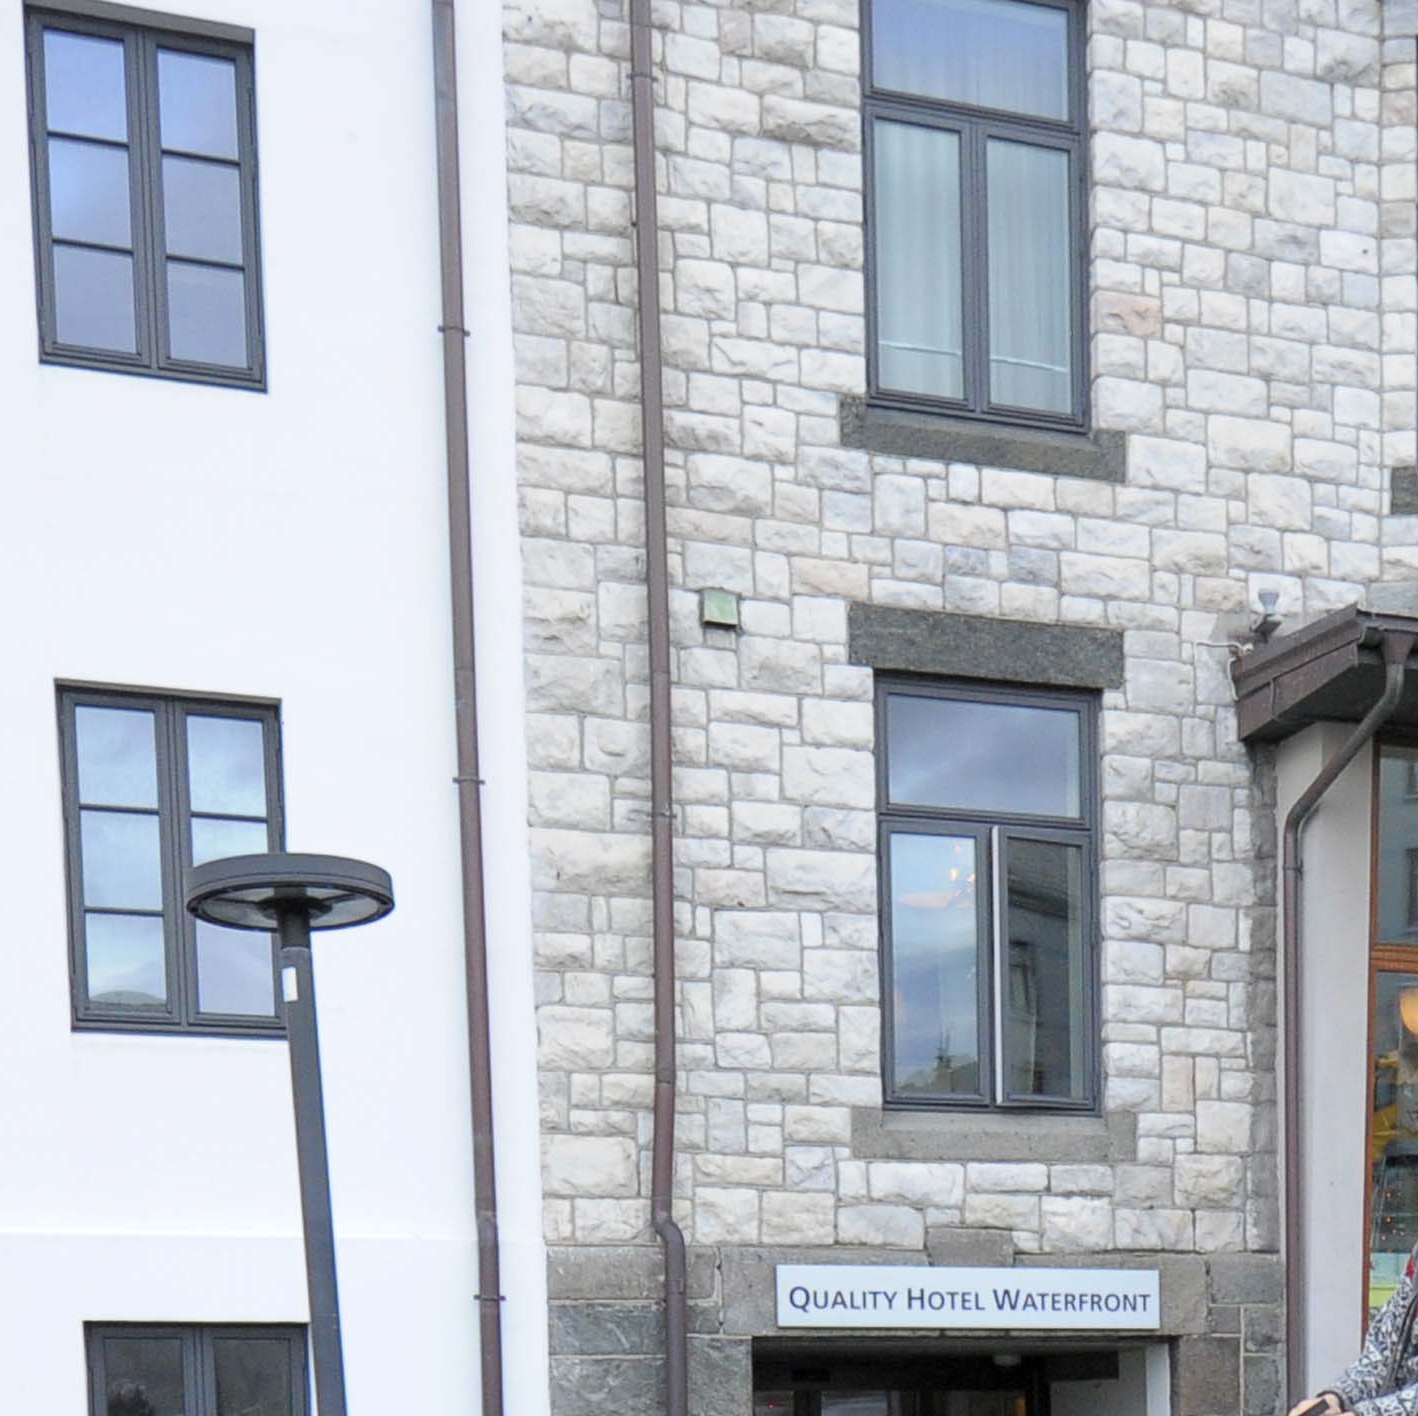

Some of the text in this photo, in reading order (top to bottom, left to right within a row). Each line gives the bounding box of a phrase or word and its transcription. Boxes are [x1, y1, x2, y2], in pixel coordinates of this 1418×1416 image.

[789, 1286, 1151, 1313] QUALITY HOTEL WATERFRONT
